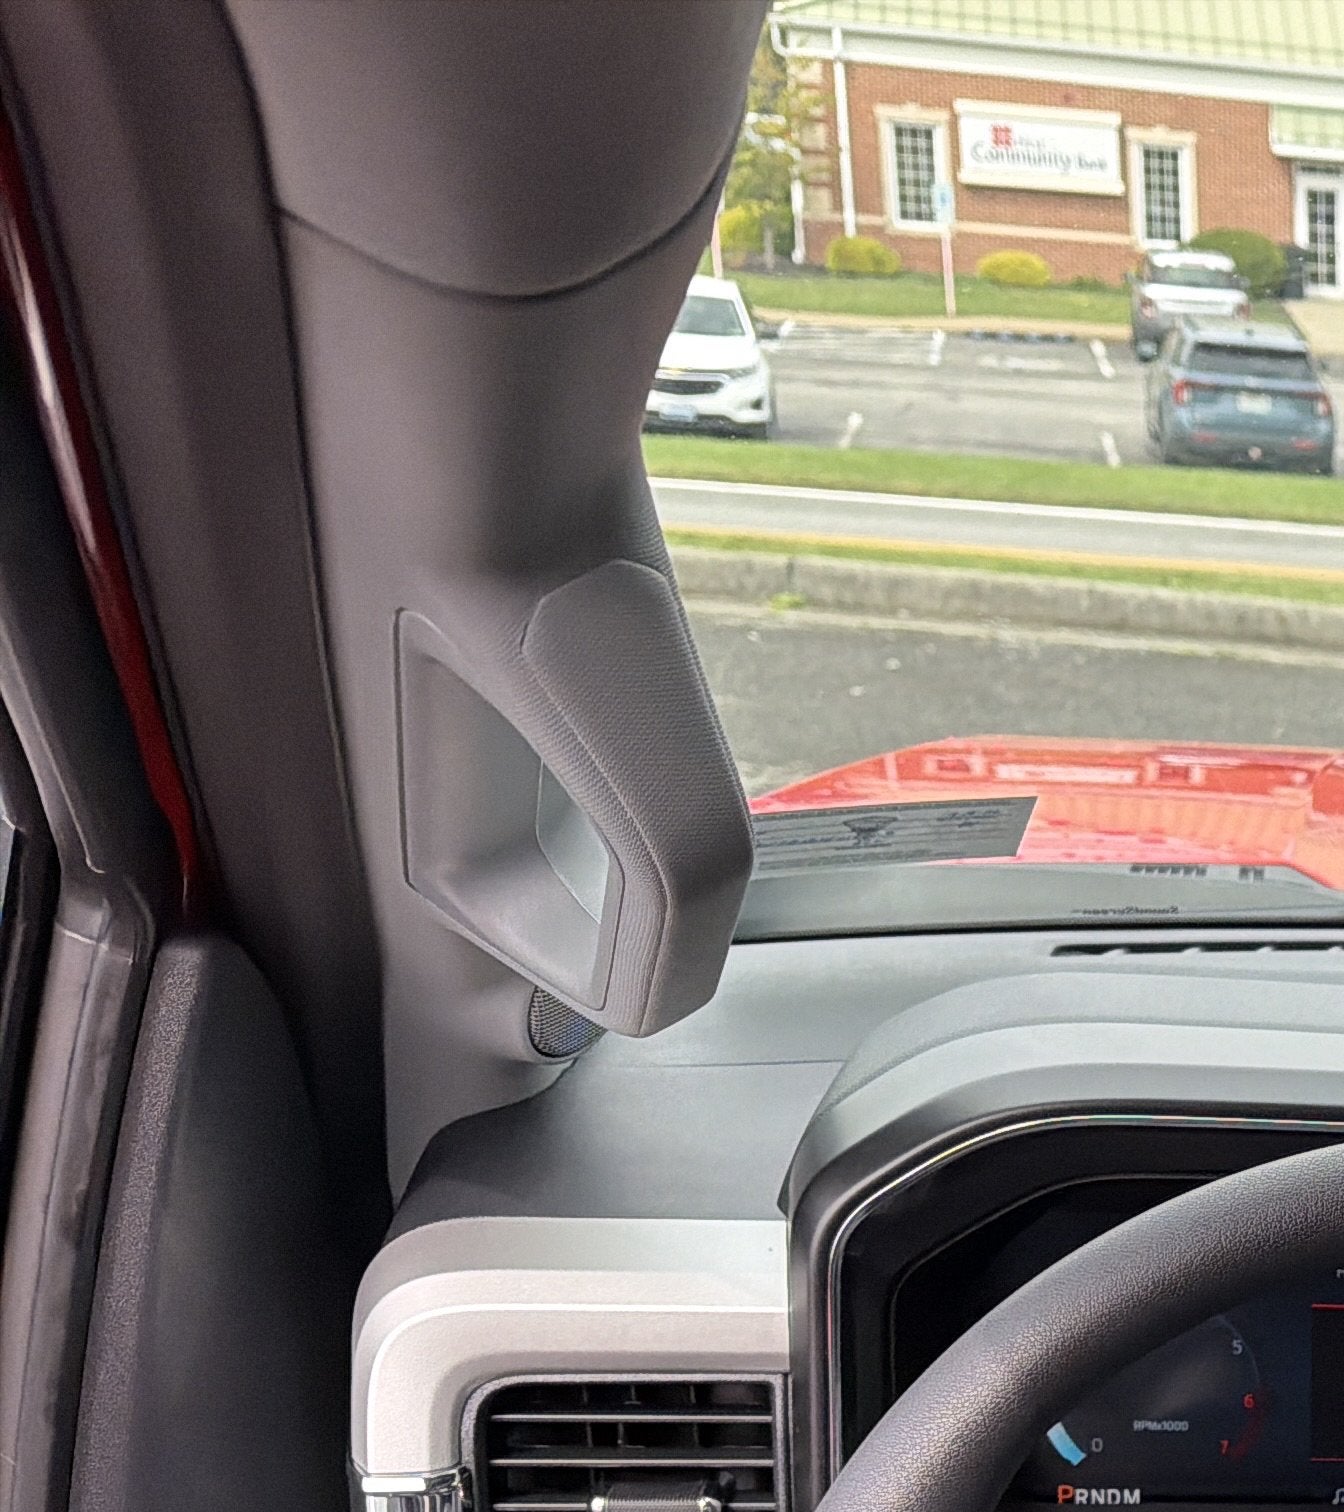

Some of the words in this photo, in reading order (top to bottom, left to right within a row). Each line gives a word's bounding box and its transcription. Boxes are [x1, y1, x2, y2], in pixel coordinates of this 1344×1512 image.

[1231, 1339, 1244, 1356] 5
[1243, 1393, 1254, 1409] 6
[1091, 1437, 1104, 1453] 0
[1220, 1439, 1230, 1455] 7
